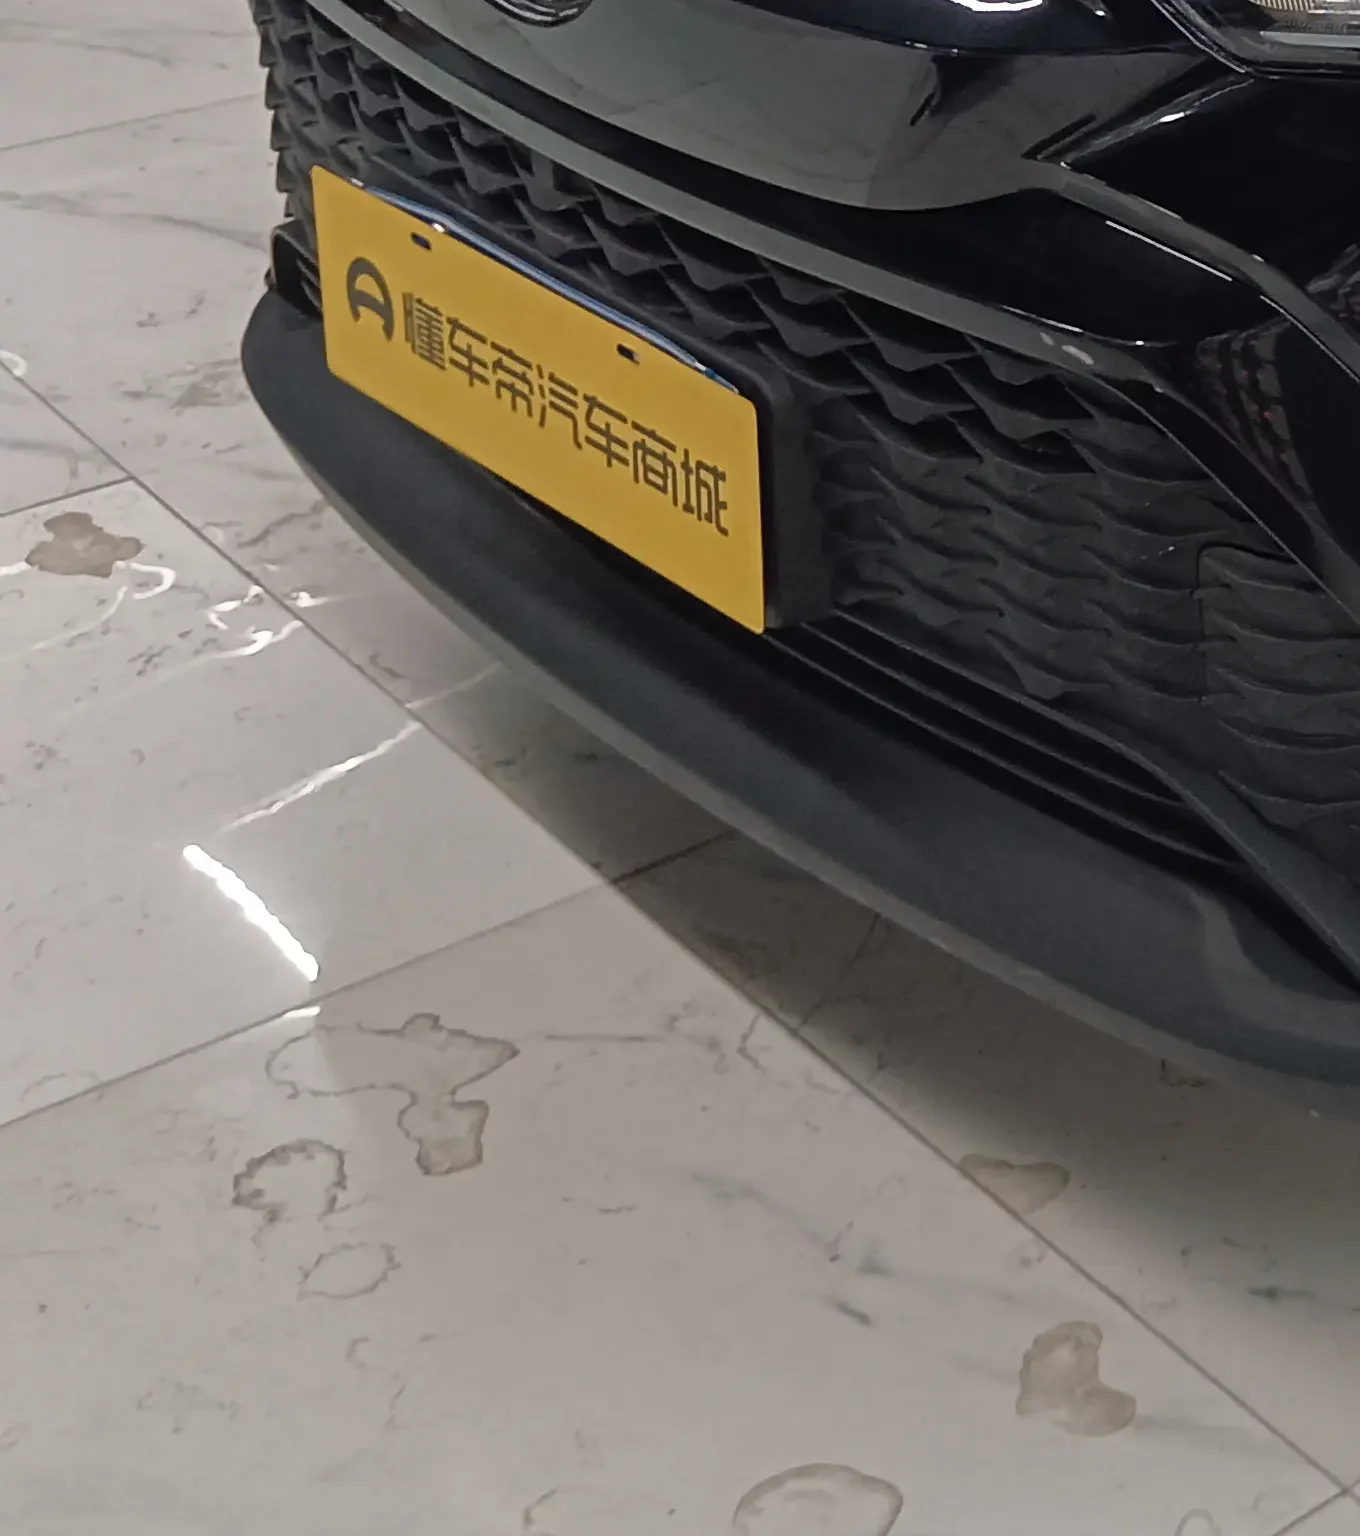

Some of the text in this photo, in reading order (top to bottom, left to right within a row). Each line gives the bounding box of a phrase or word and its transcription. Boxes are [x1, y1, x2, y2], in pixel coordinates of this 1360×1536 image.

[402, 292, 729, 537] 懂车帝汽车商城
